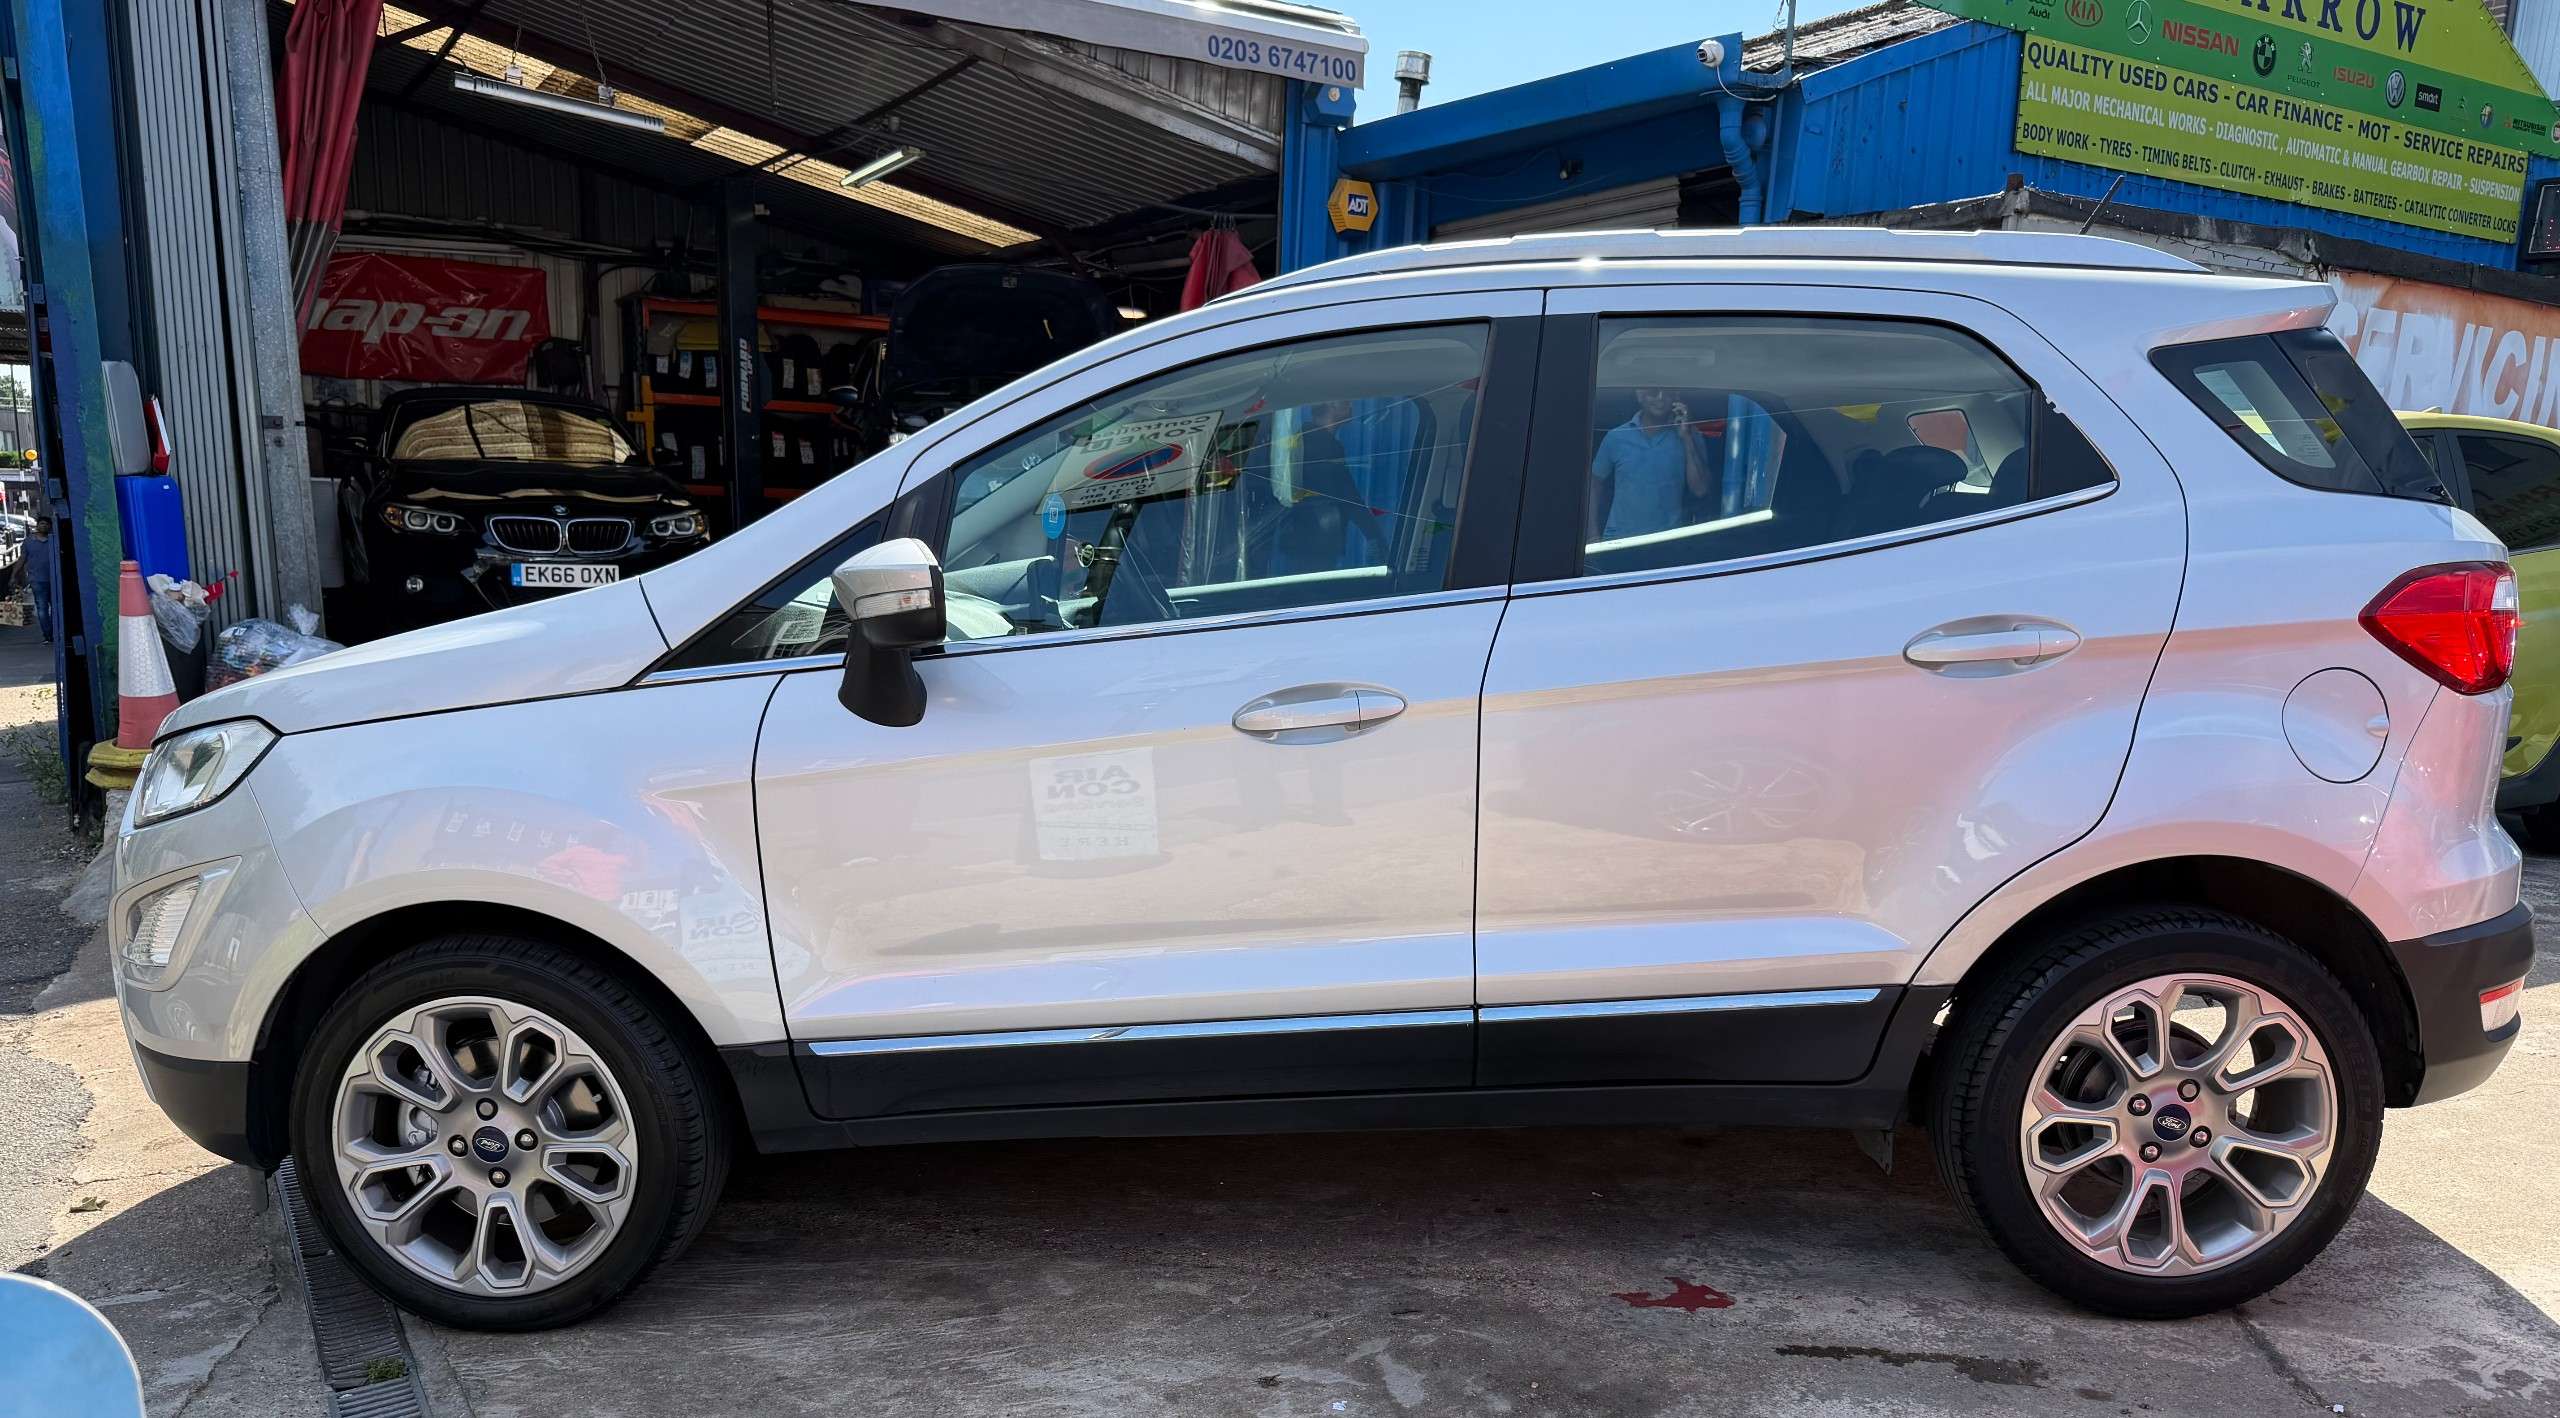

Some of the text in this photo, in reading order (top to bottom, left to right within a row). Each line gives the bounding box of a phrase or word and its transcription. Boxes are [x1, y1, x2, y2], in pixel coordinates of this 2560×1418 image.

[2028, 6, 2050, 20] Audi
[2071, 0, 2096, 21] KIA
[2162, 20, 2240, 56] NISSAN
[1208, 35, 1356, 82] 0203 6747100
[2288, 74, 2320, 88] PEUGEOT
[2333, 66, 2375, 89] ISUZU
[2028, 42, 2114, 80] QUALITY
[2119, 65, 2168, 92] USED
[2173, 75, 2219, 104] CARS
[2236, 90, 2270, 117] CAR
[2274, 99, 2344, 133] FINANCE
[2358, 119, 2391, 143] MOT
[2404, 130, 2464, 161] SERVICE
[2467, 145, 2526, 174] REPAIRS
[2419, 91, 2439, 105] smart
[2026, 81, 2048, 103] ALL
[2051, 88, 2091, 113] MAJOR
[2093, 95, 2165, 127] MECHANICAL
[2168, 111, 2207, 136] WORKS
[2215, 120, 2279, 151] DIAGNOSTIC
[2285, 135, 2341, 165] AUTOMATIC
[2343, 151, 2351, 166] &
[2352, 152, 2388, 176] MANUAL
[2390, 159, 2430, 185] GEARBOX
[2432, 169, 2463, 193] REPAIR
[2469, 178, 2521, 202] SUSPENSION
[2022, 122, 2054, 140] BODY
[2057, 127, 2089, 151] WORK
[2100, 137, 2132, 159] TYRES
[2142, 145, 2179, 168] TIMING
[2182, 155, 2211, 174] BELTS
[2219, 161, 2256, 183] CLUTCH
[2264, 171, 2305, 193] EXHAUST
[2312, 180, 2346, 201] BRAKES
[2353, 188, 2398, 211] BATTERIES
[2404, 199, 2447, 221] CATALYTIC
[2447, 210, 2492, 229] CONVERTER
[2492, 217, 2517, 235] LOCKS
[1349, 196, 1368, 214] ADT
[738, 337, 752, 414] FORWARD
[525, 566, 617, 584] EK66 OXN
[2162, 1117, 2182, 1129] Ford
[480, 1138, 501, 1150] Ford
